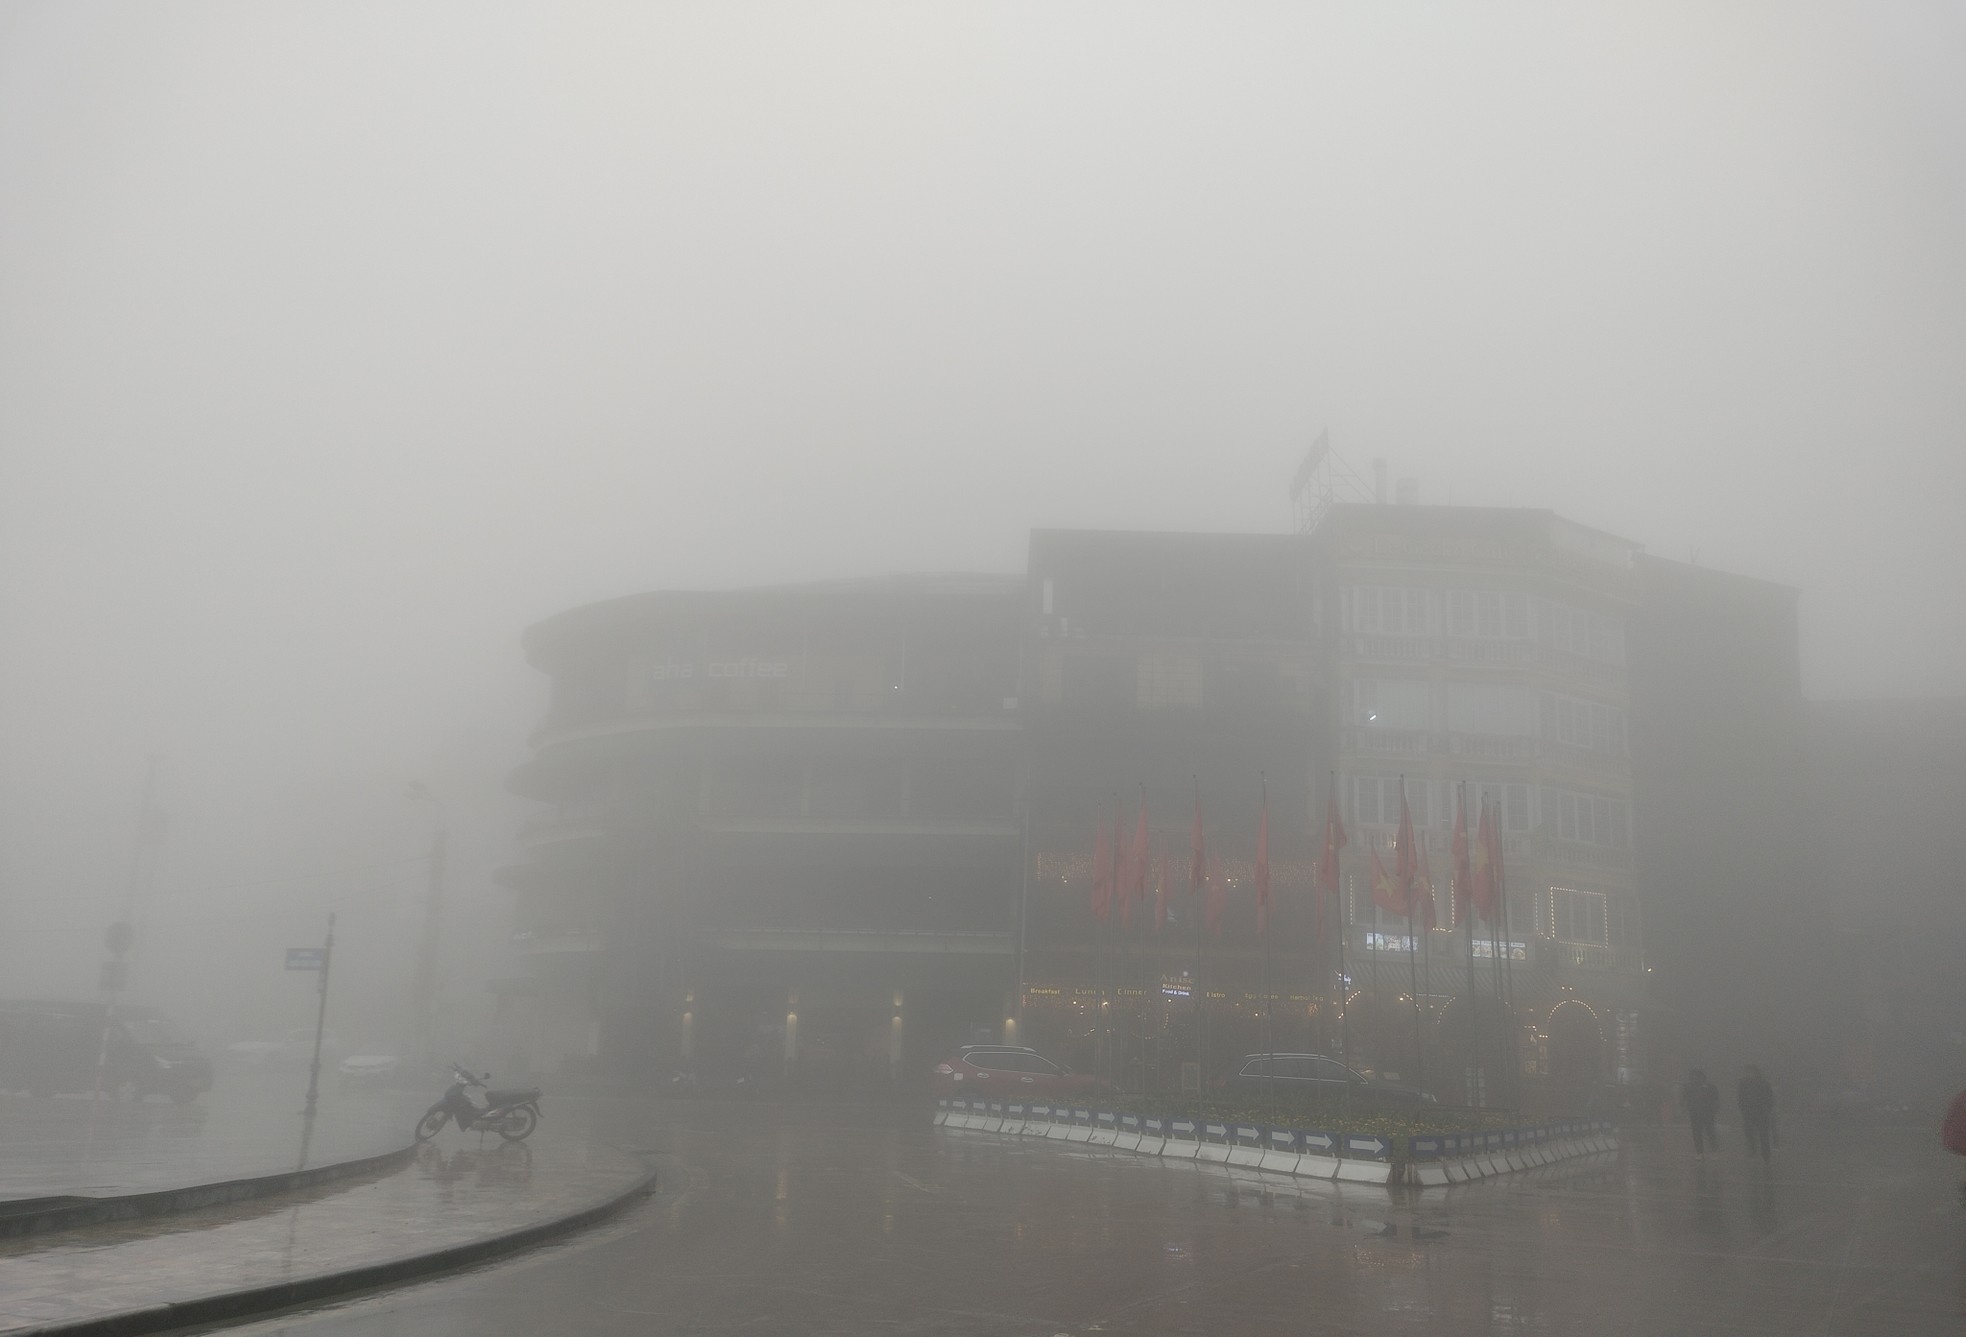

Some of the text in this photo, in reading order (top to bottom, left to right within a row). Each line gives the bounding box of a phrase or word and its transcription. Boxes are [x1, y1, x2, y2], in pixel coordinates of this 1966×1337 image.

[653, 656, 789, 681] aha coffee
[1030, 986, 1061, 996] Breakfast
